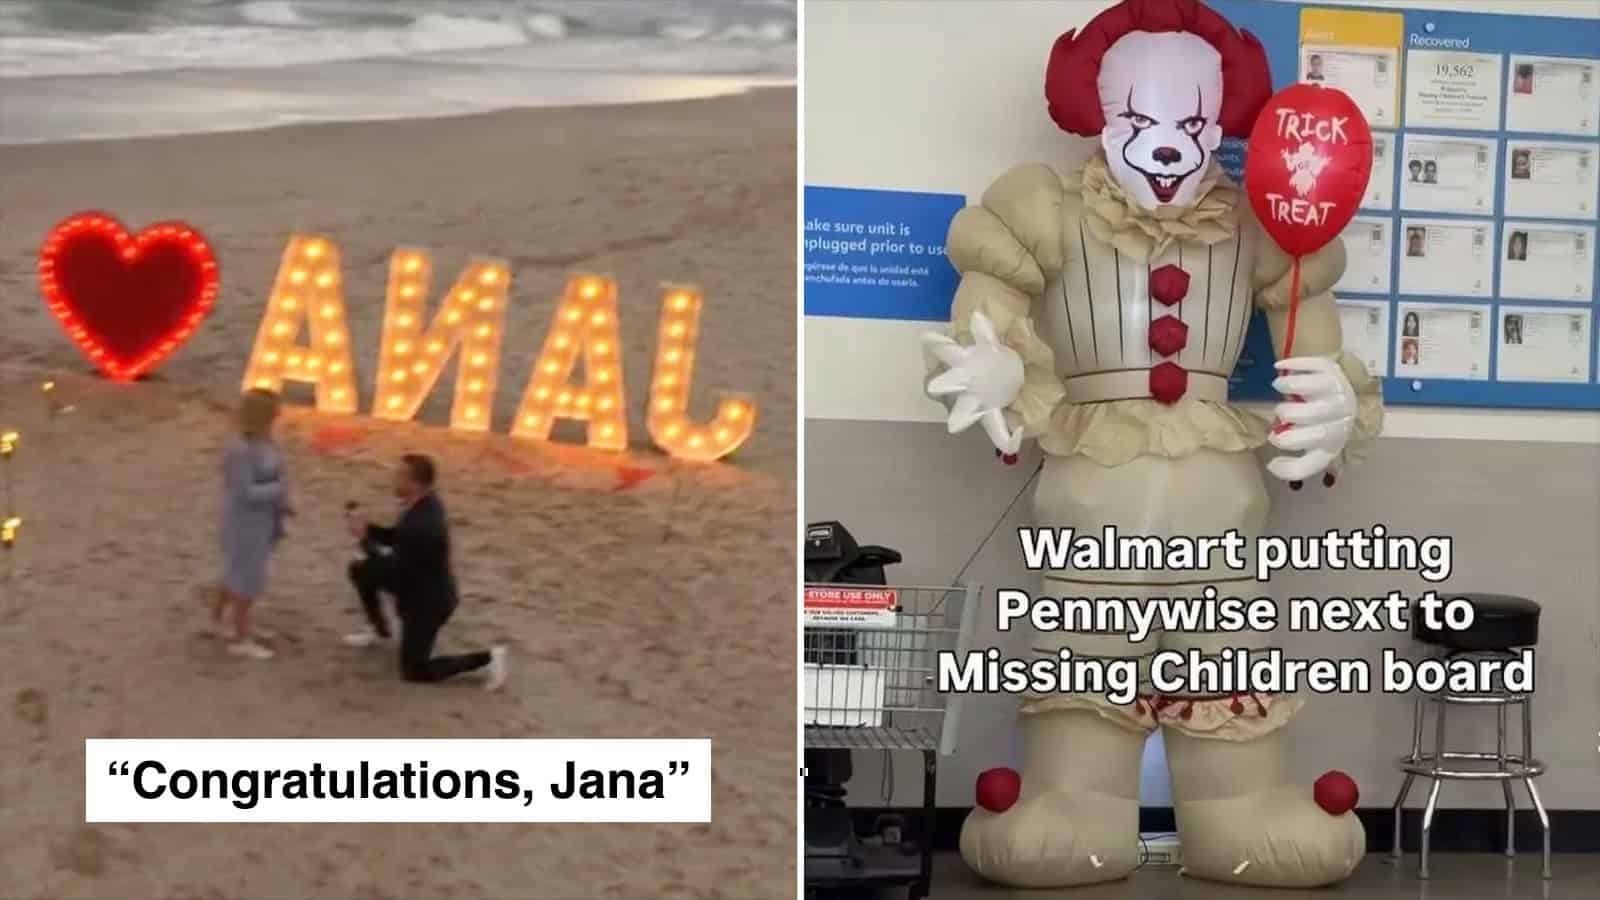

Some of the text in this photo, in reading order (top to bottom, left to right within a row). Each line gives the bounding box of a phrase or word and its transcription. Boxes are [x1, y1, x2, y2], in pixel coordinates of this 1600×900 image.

[1410, 33, 1470, 48] Recovered
[1435, 63, 1474, 78] 19,562
[1276, 108, 1349, 145] TRICK
[1266, 193, 1336, 226] TREAT
[834, 221, 865, 234] sure
[868, 221, 896, 236] unit
[899, 222, 911, 236] is
[871, 240, 905, 256] prior
[909, 242, 924, 254] to
[843, 590, 863, 600] USE
[864, 590, 891, 601] ONLY
